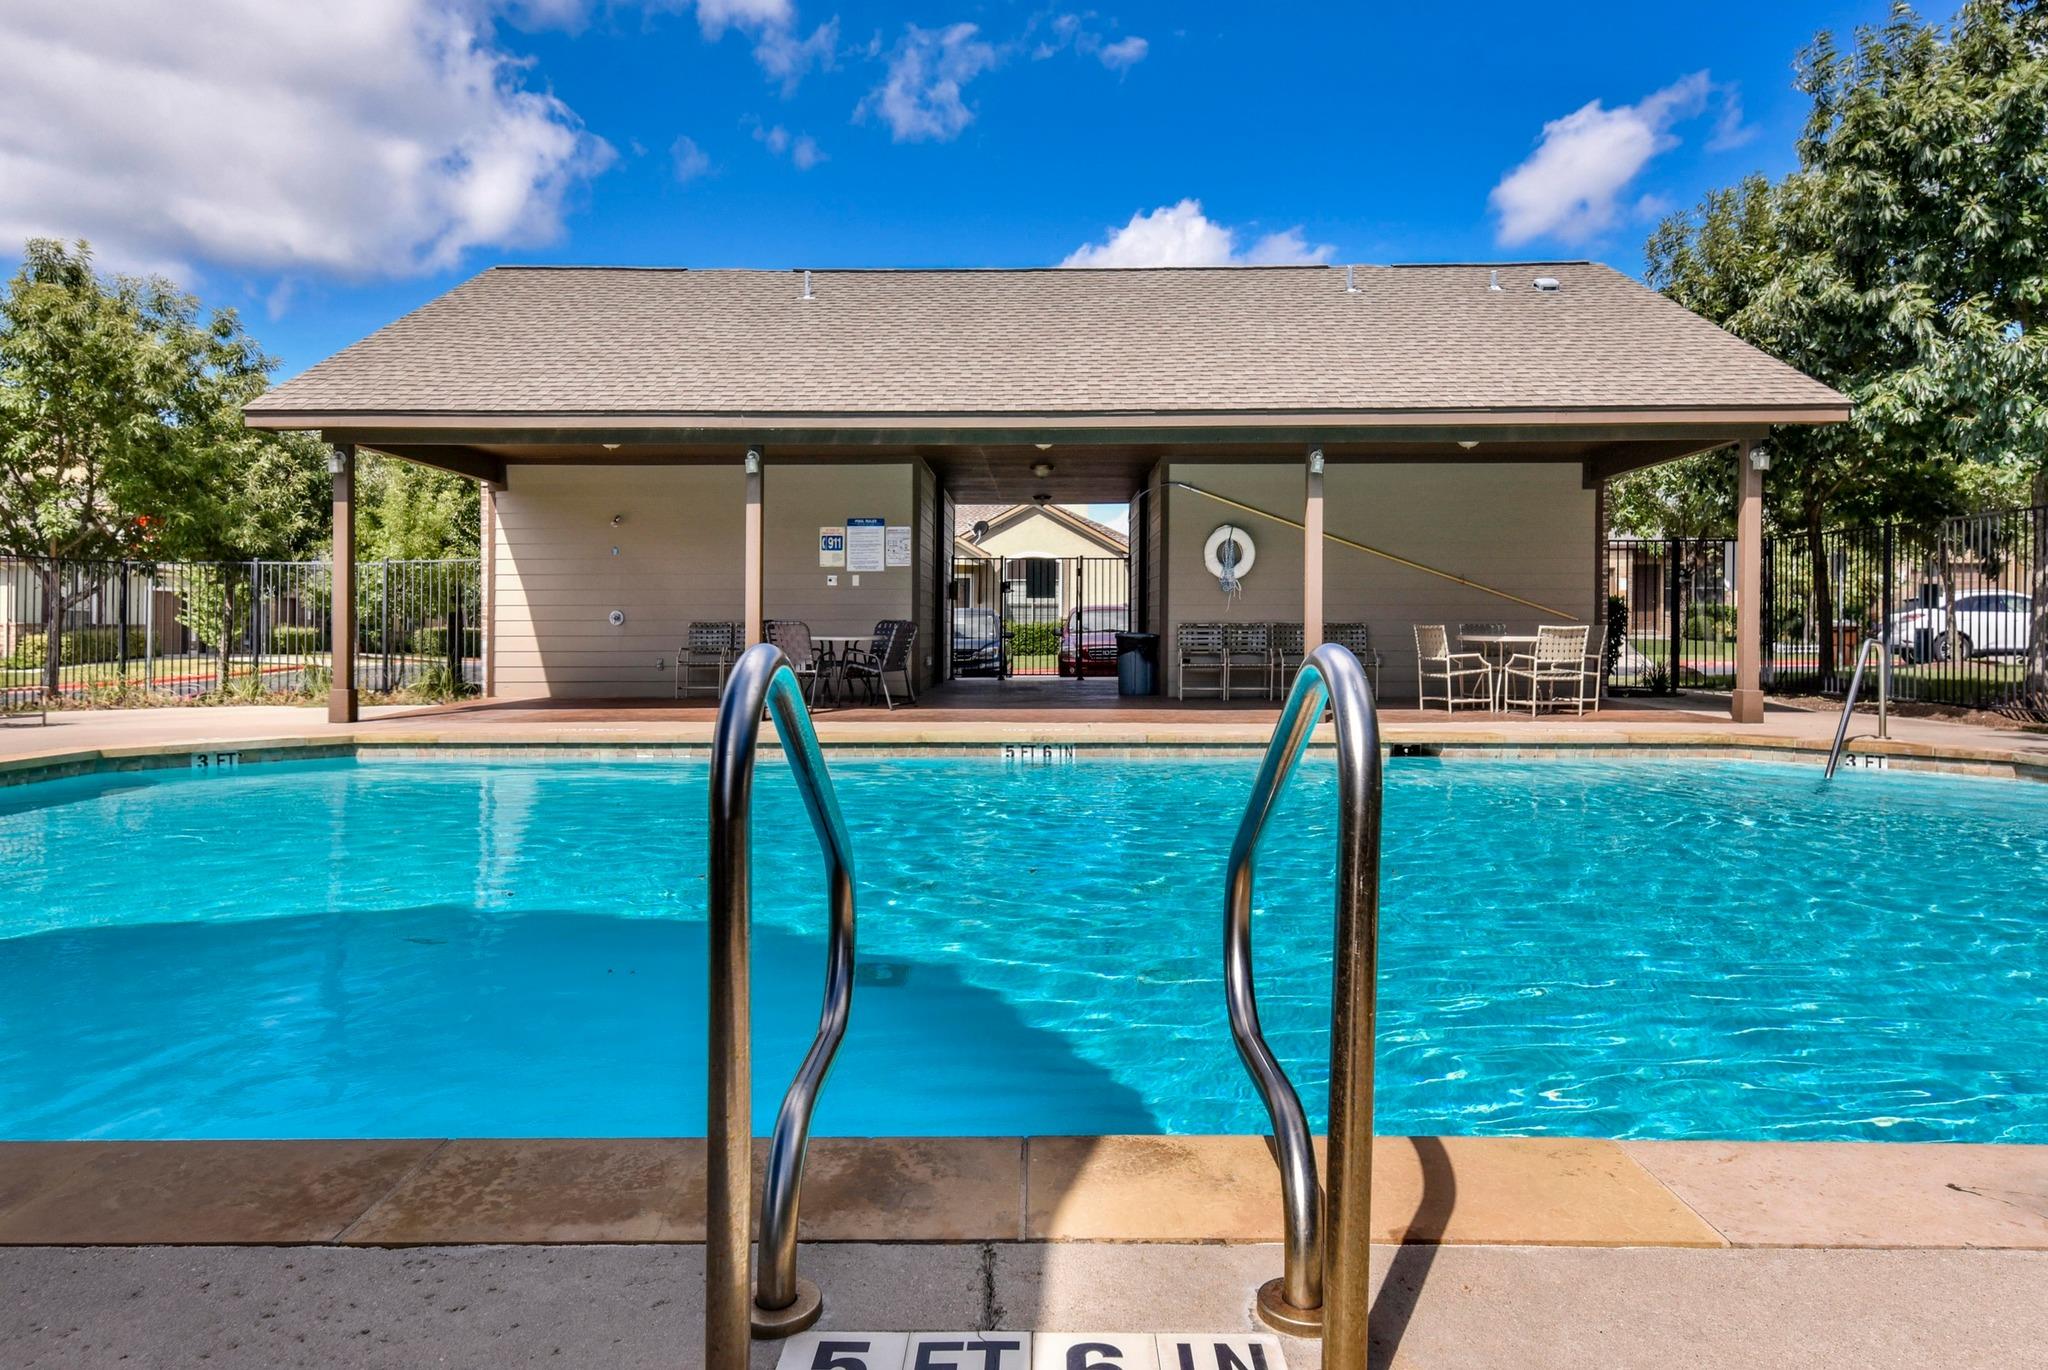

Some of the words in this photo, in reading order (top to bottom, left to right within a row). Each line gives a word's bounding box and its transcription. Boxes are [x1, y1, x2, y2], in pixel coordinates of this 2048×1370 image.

[828, 537, 842, 549] 911
[1006, 745, 1014, 758] 5
[1021, 745, 1036, 758] FT
[1043, 745, 1052, 758] 6
[1060, 745, 1073, 758] IN
[197, 754, 209, 767] 3
[216, 752, 237, 766] FT
[1845, 753, 1857, 767] 3
[1865, 754, 1885, 768] FT
